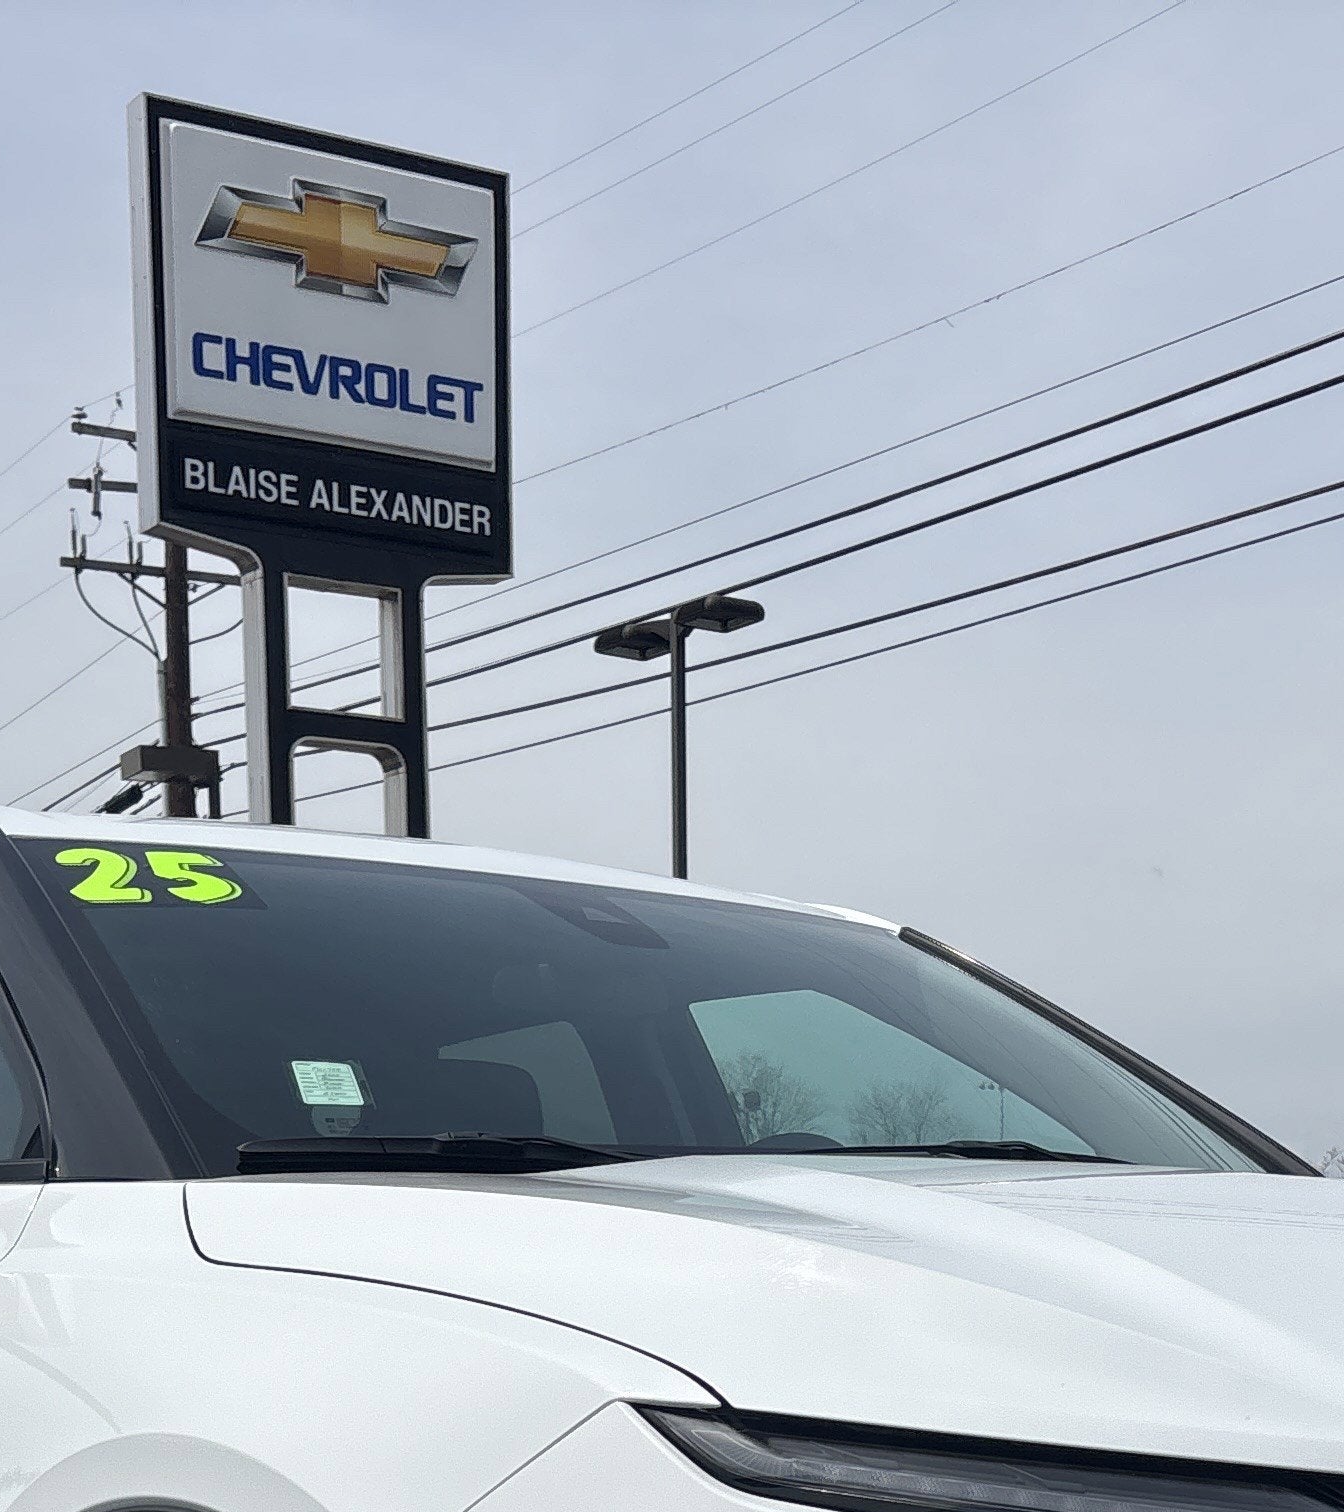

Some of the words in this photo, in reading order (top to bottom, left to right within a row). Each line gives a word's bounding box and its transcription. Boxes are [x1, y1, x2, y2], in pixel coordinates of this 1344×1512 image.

[192, 332, 484, 424] CHEVROLET
[183, 457, 299, 507] BLAISE
[309, 479, 492, 537] ALEXANDER
[55, 848, 243, 904] 25
